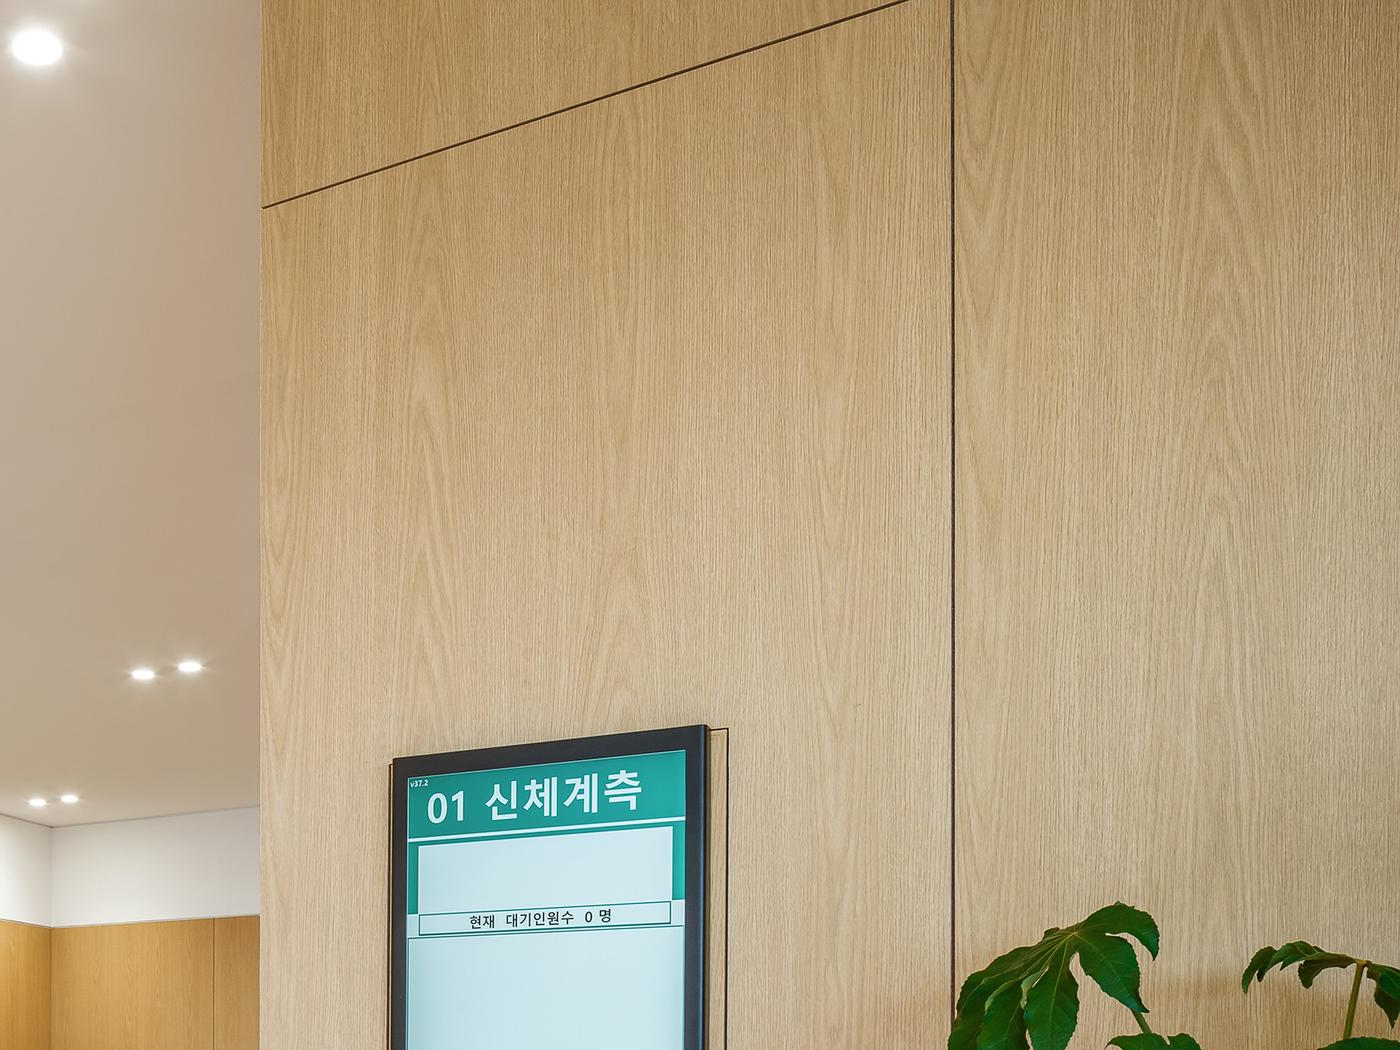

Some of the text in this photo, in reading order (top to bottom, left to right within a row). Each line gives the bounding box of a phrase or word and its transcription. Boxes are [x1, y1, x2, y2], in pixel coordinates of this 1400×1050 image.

[410, 779, 429, 788] v37.2
[427, 769, 642, 824] 01 신체계측
[470, 908, 612, 930] 현재 대기인원수 0 명
